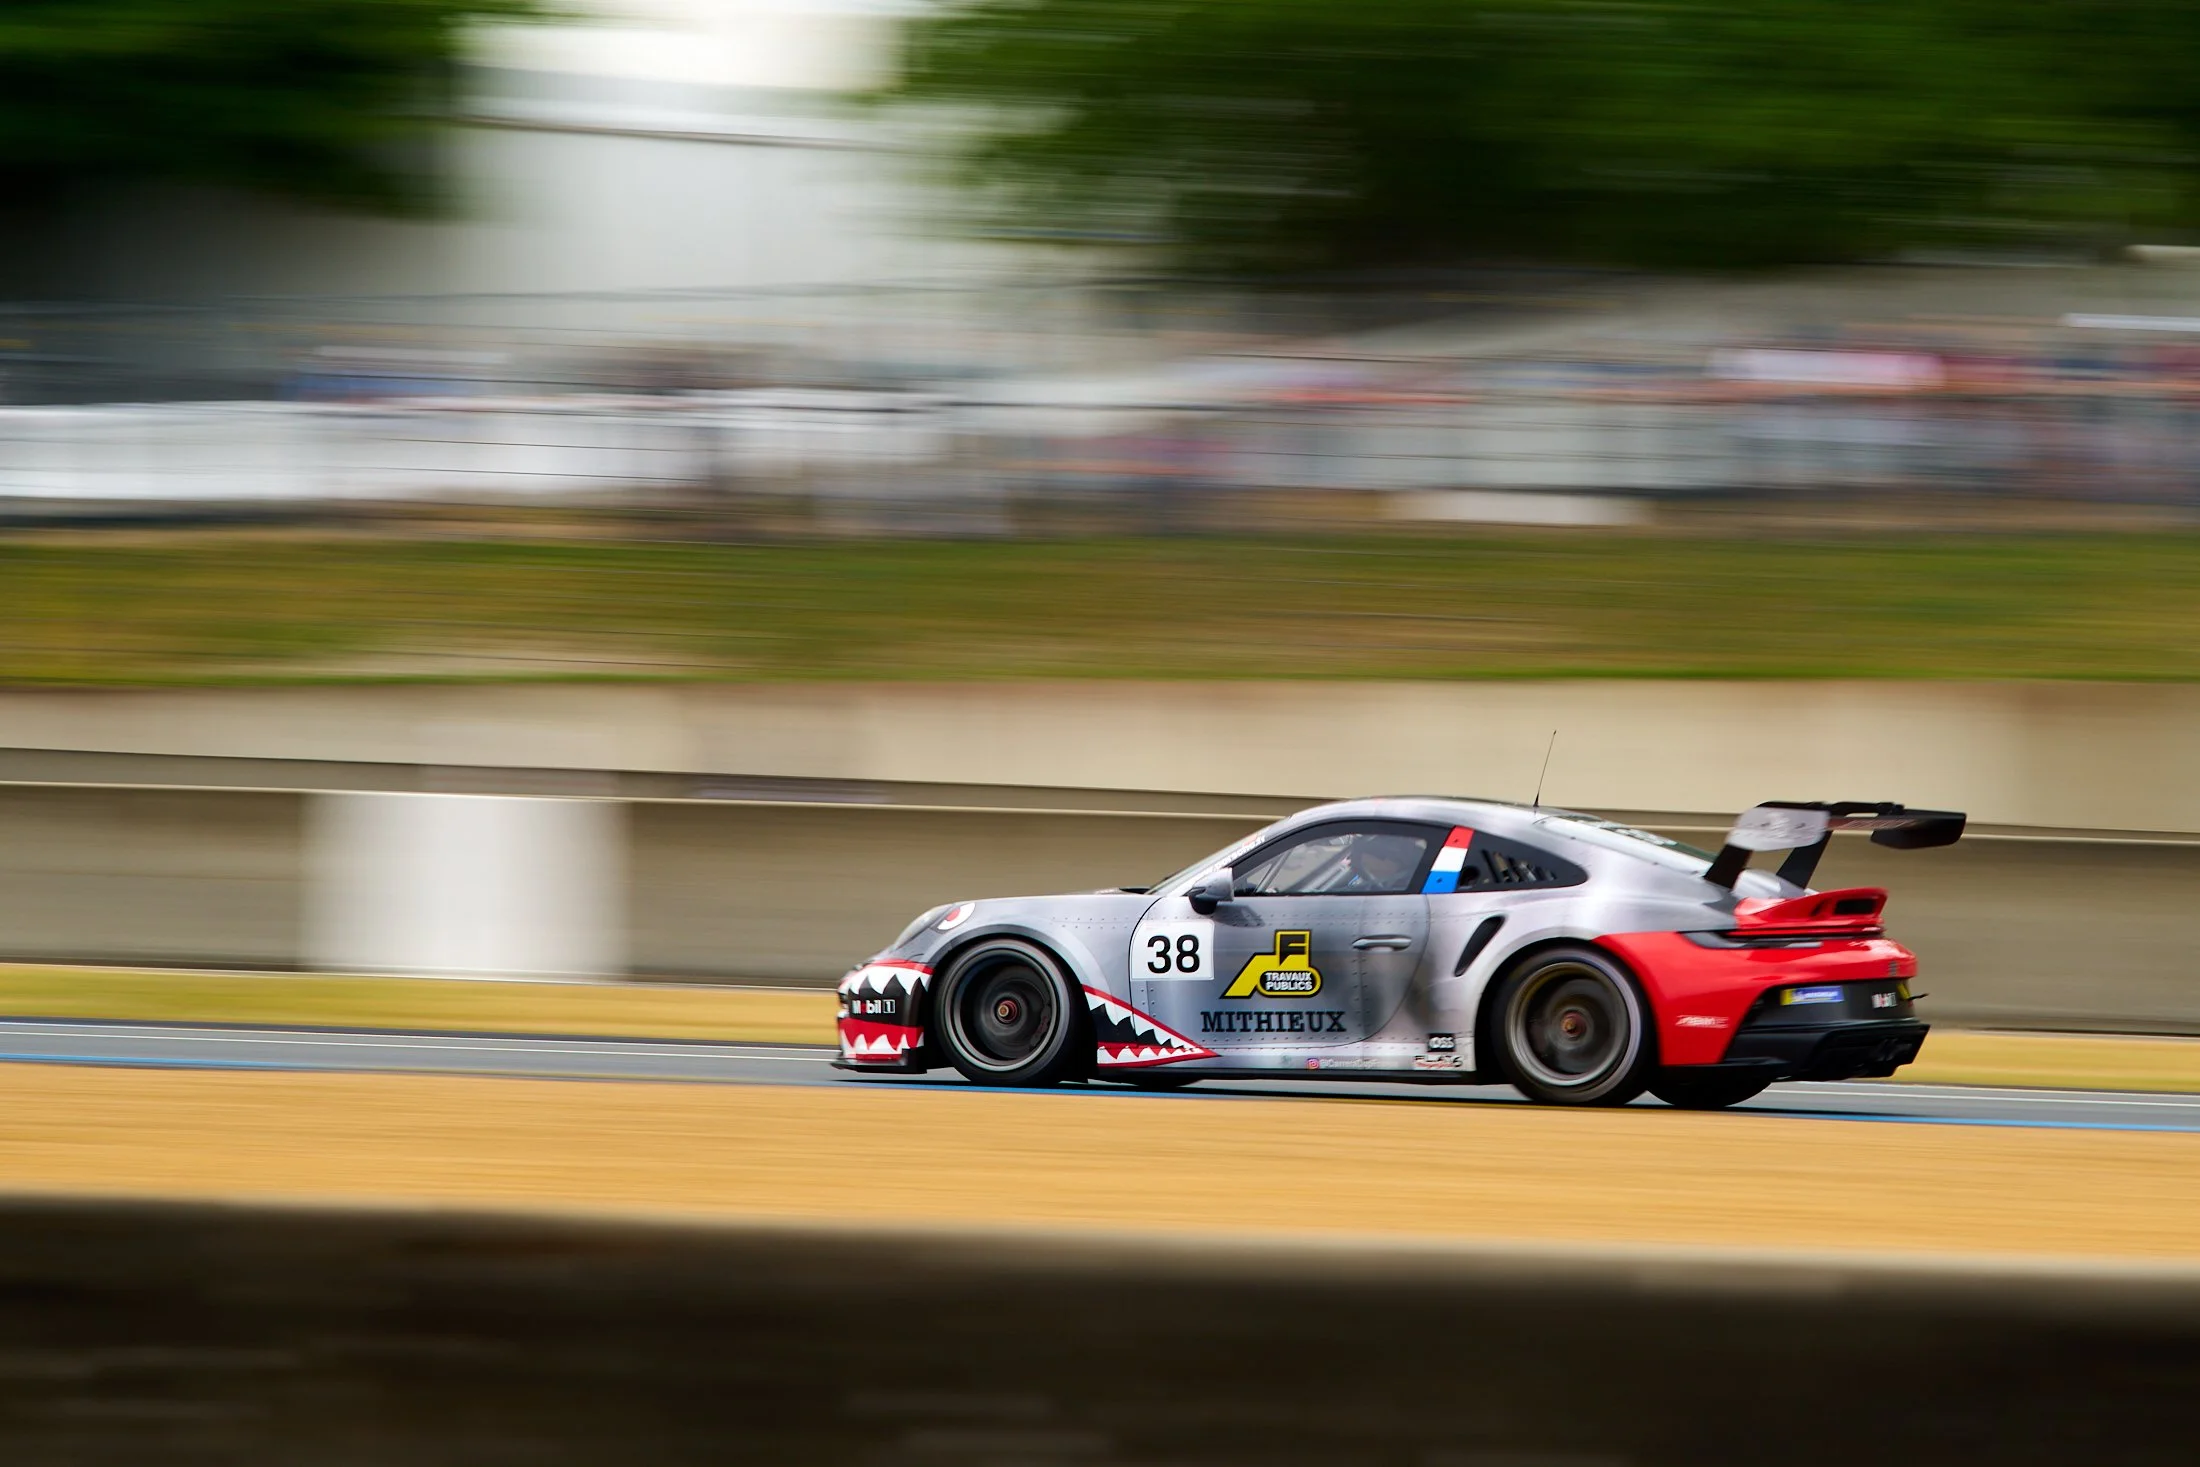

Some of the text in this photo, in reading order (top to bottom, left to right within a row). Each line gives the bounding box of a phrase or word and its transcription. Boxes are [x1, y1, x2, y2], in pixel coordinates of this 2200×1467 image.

[1147, 934, 1200, 974] 38
[1265, 972, 1312, 981] TRAVAUX
[1265, 981, 1313, 991] PUBLICS
[1200, 1011, 1347, 1032] MITHIEUX
